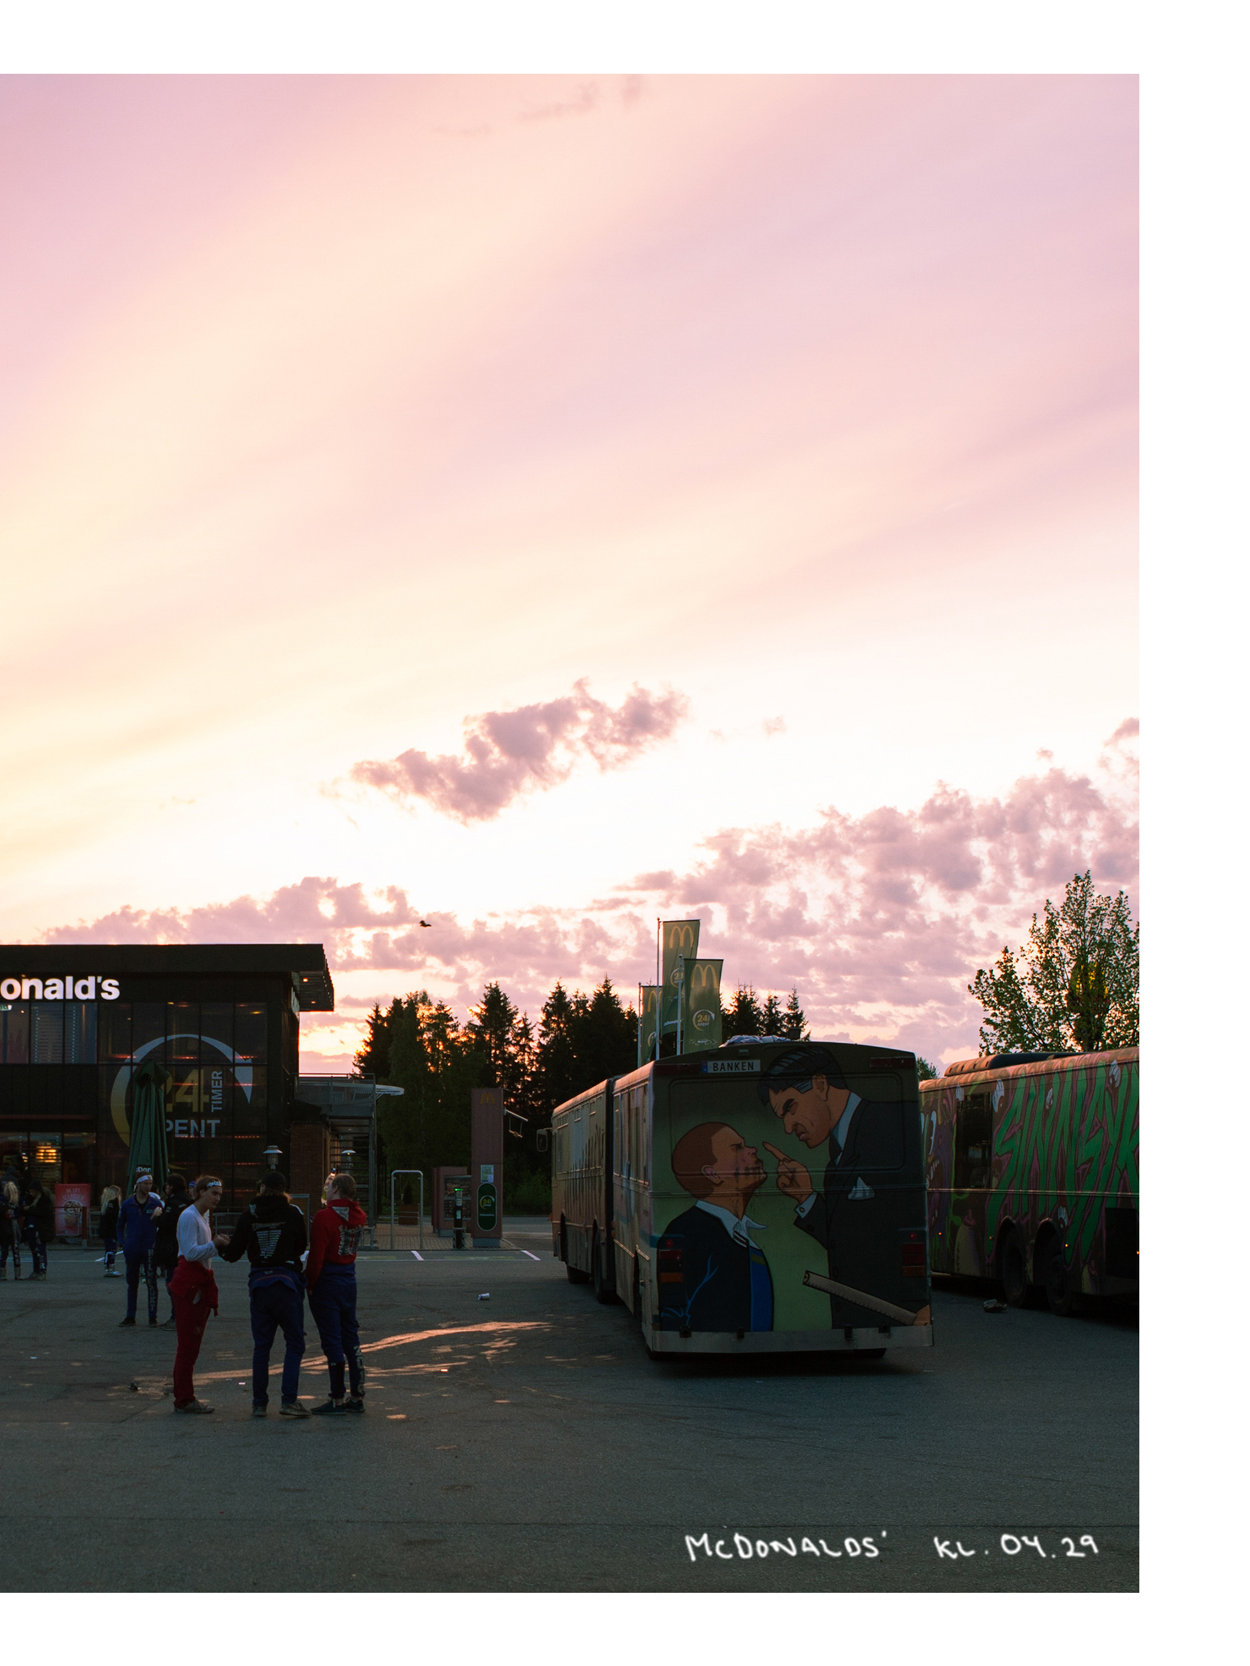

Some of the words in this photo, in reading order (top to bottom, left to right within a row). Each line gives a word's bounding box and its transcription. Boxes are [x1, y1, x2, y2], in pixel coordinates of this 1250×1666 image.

[712, 1061, 754, 1071] BANKEN
[211, 1070, 223, 1113] TIMER
[165, 1119, 221, 1138] PENT
